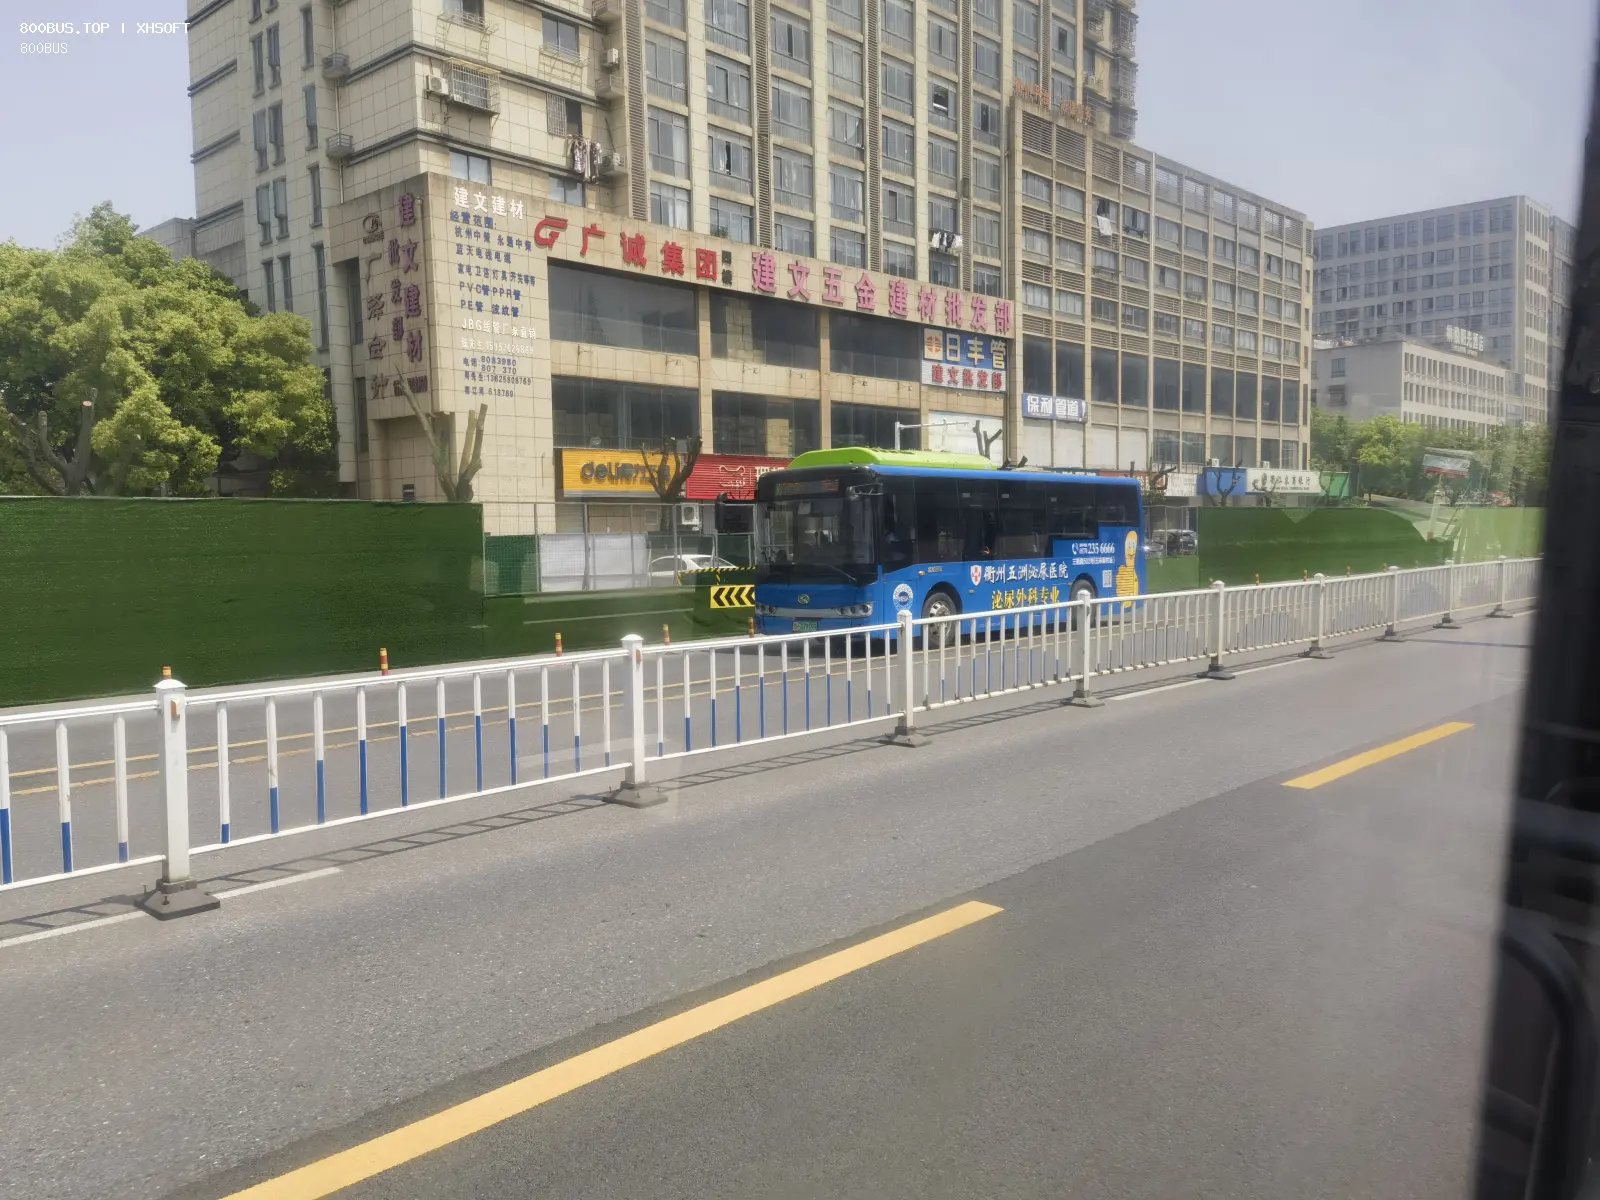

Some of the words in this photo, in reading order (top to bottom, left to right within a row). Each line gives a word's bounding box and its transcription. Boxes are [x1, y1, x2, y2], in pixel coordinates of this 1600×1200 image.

[453, 186, 525, 220] 建文建材
[580, 224, 718, 282] 广诚集团
[752, 251, 1012, 334] 建文五金建材批发部
[946, 333, 1006, 368] 日丰管
[931, 364, 1003, 390] 建文批发部
[1026, 394, 1080, 417] 保利管道
[983, 561, 1069, 584] 衢州五洲泌尿医院
[992, 586, 1060, 610] 泌尿外科专业
